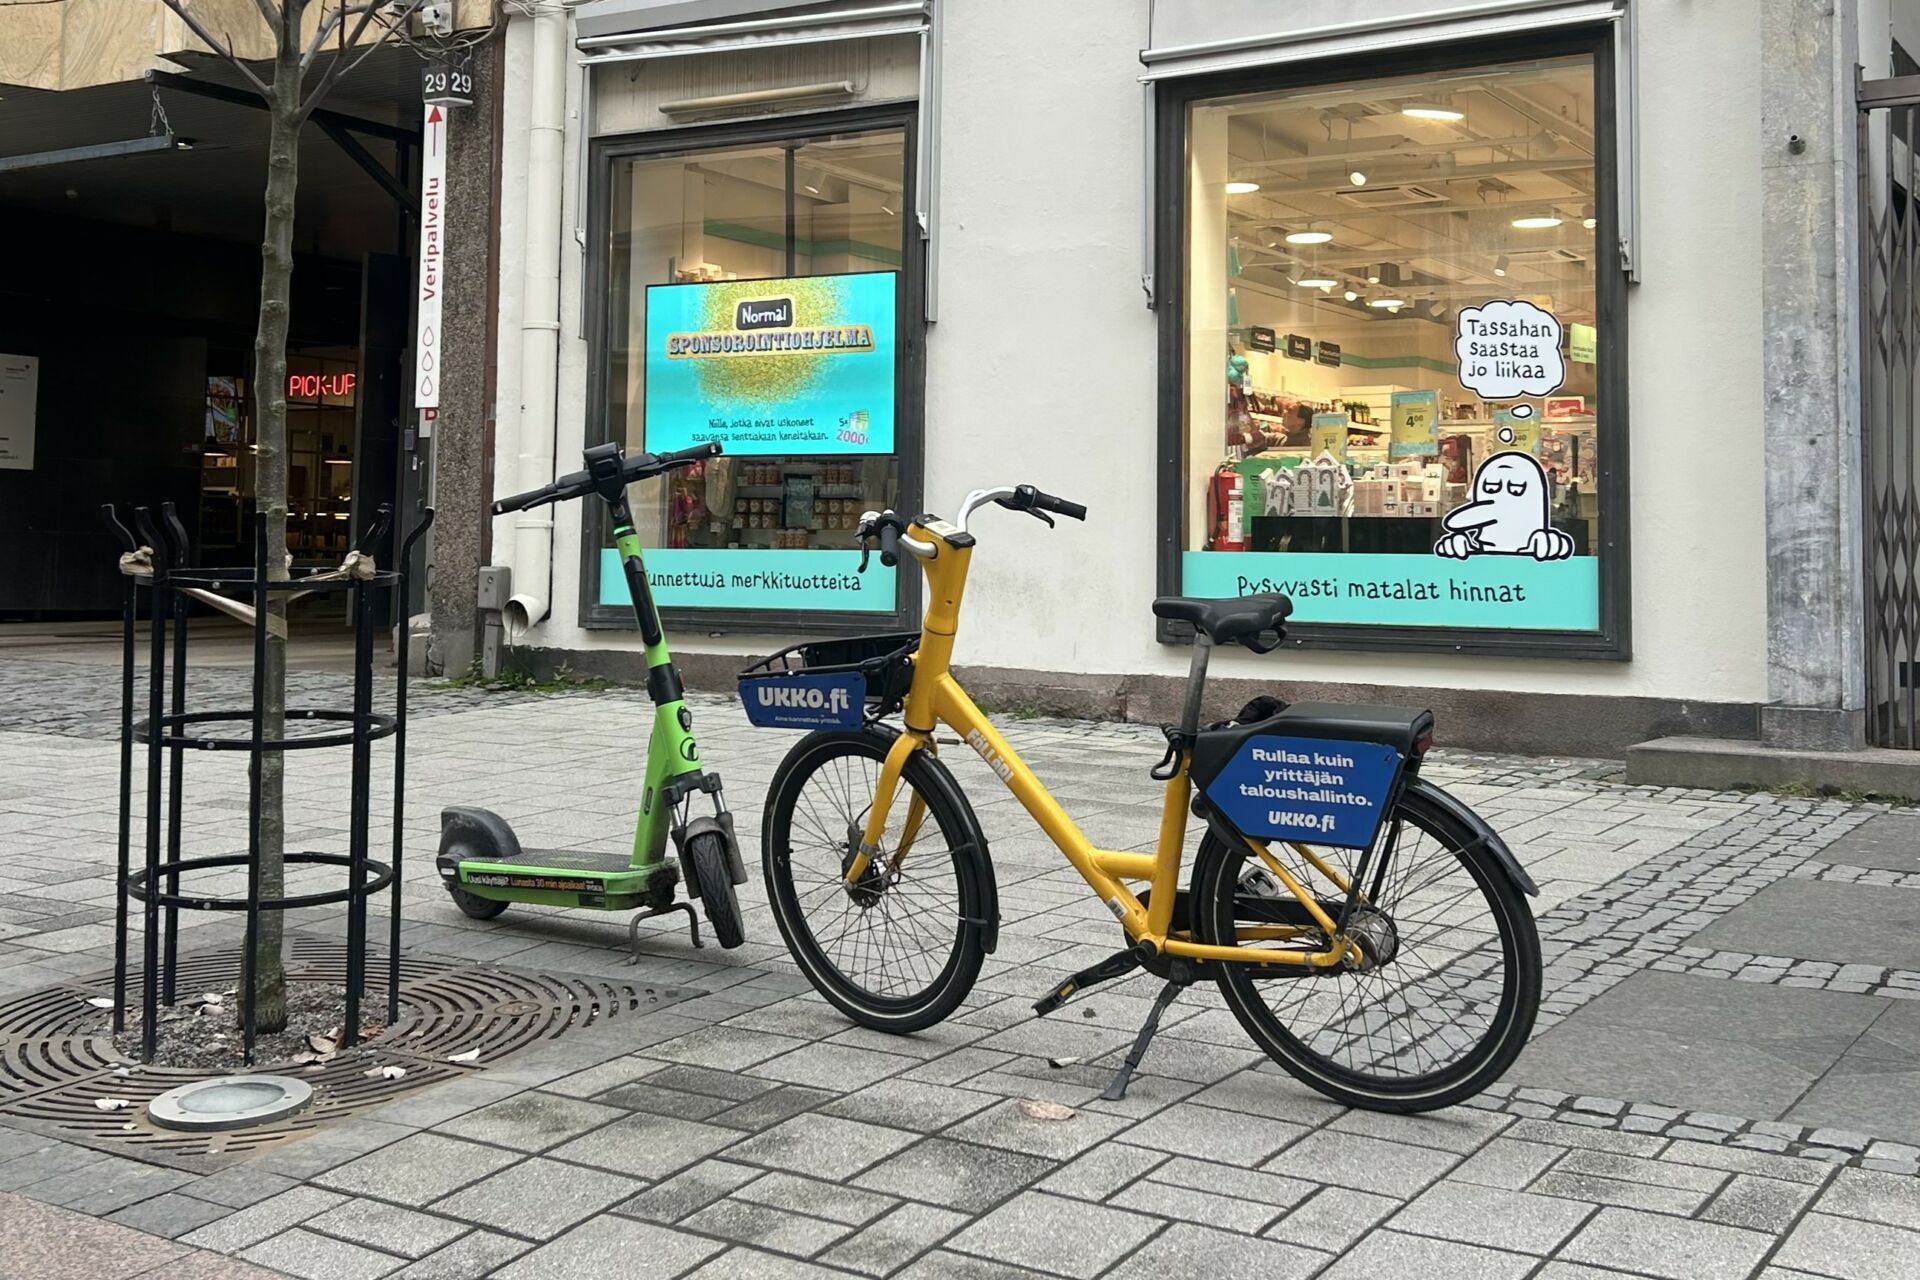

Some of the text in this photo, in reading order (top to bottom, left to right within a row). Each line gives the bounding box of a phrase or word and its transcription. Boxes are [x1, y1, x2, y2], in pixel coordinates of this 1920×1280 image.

[425, 73, 447, 94] 29
[451, 72, 472, 94] 29
[423, 177, 440, 301] Veripalvelu
[742, 304, 787, 324] Normal
[1467, 318, 1552, 338] Tässähän
[670, 328, 872, 355] SPONSOROINTIOHJELMA
[1468, 360, 1546, 379] jo liikaa
[289, 374, 356, 397] PICK-UP
[646, 569, 861, 591] unnettuja merkkituotteita
[1237, 575, 1526, 602] Pysyvästi matalat hinnat
[757, 686, 850, 714] UKKO.fi
[1251, 748, 1354, 768] Rullaa kuin
[1264, 768, 1344, 787] yrittäjän
[1239, 783, 1373, 807] taloushallinto.
[1268, 810, 1336, 832] UKKO.fi
